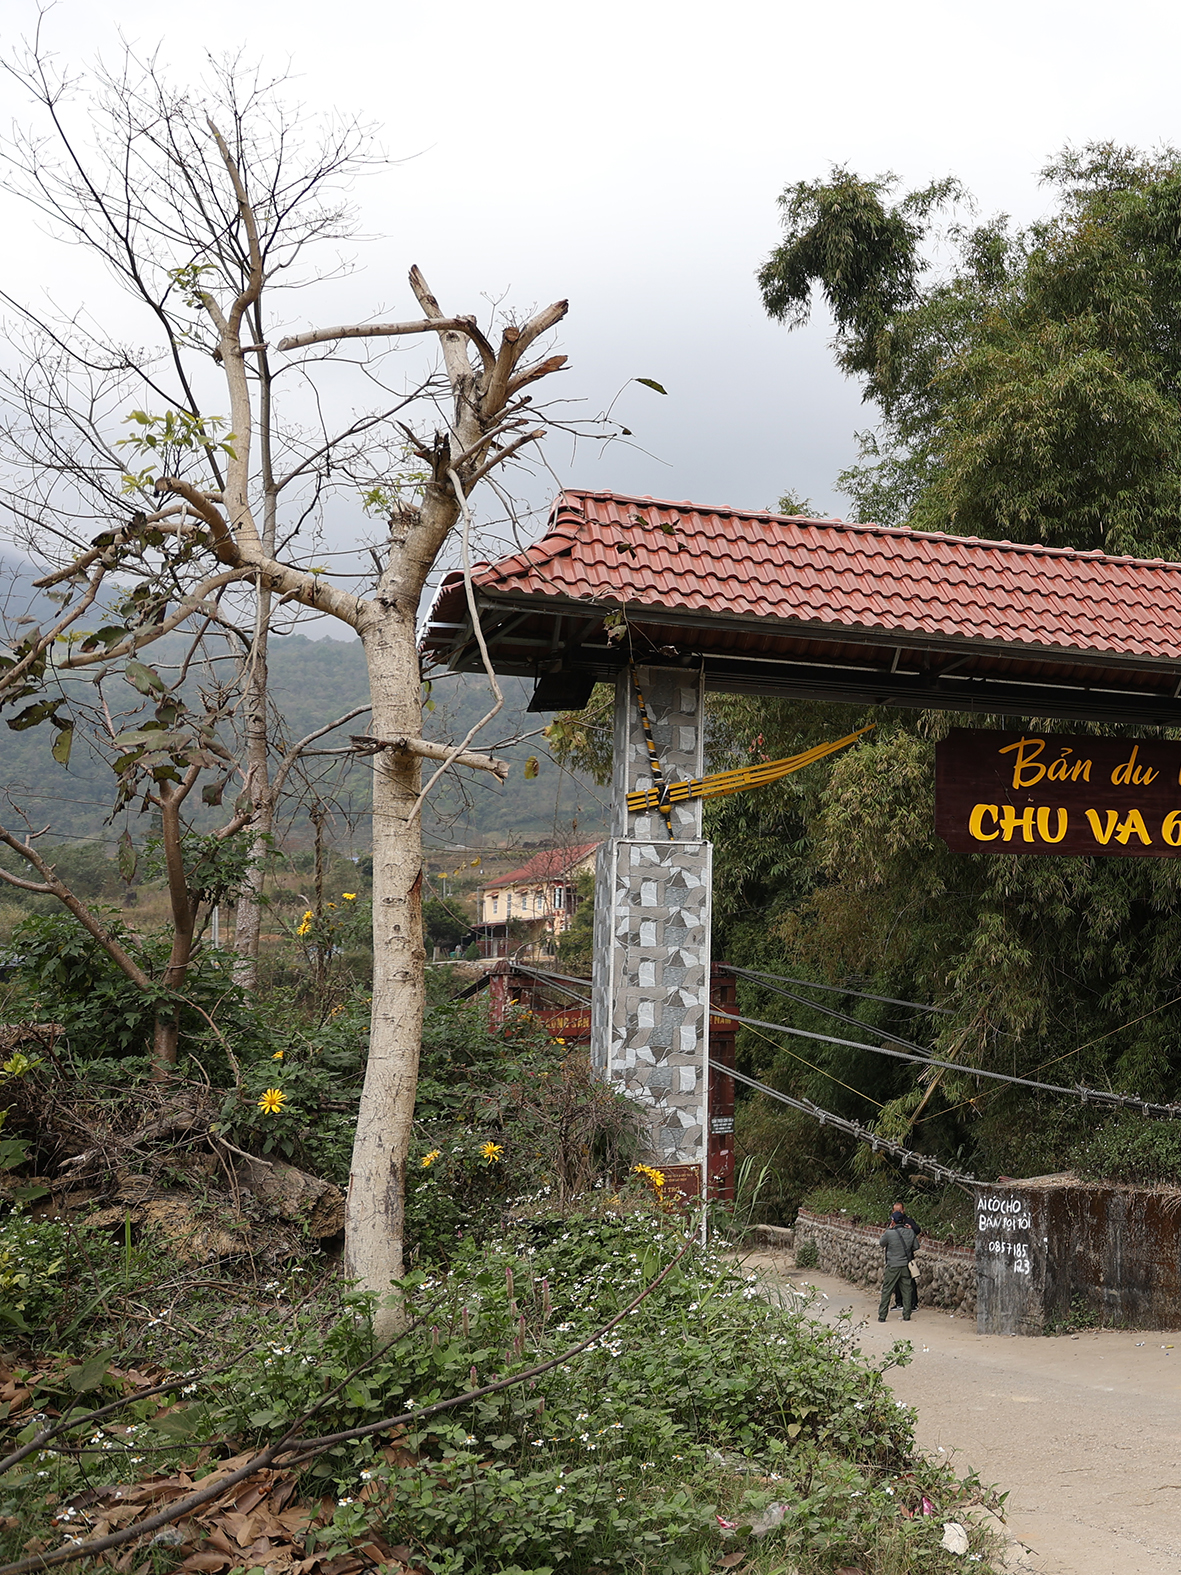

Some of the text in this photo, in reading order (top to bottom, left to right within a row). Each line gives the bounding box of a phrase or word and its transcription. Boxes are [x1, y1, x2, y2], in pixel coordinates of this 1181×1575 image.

[998, 736, 1092, 789] Bản
[1111, 745, 1159, 785] du
[969, 803, 1068, 843] CHU
[1085, 808, 1152, 846] VA
[1013, 1260, 1030, 1275] 123
